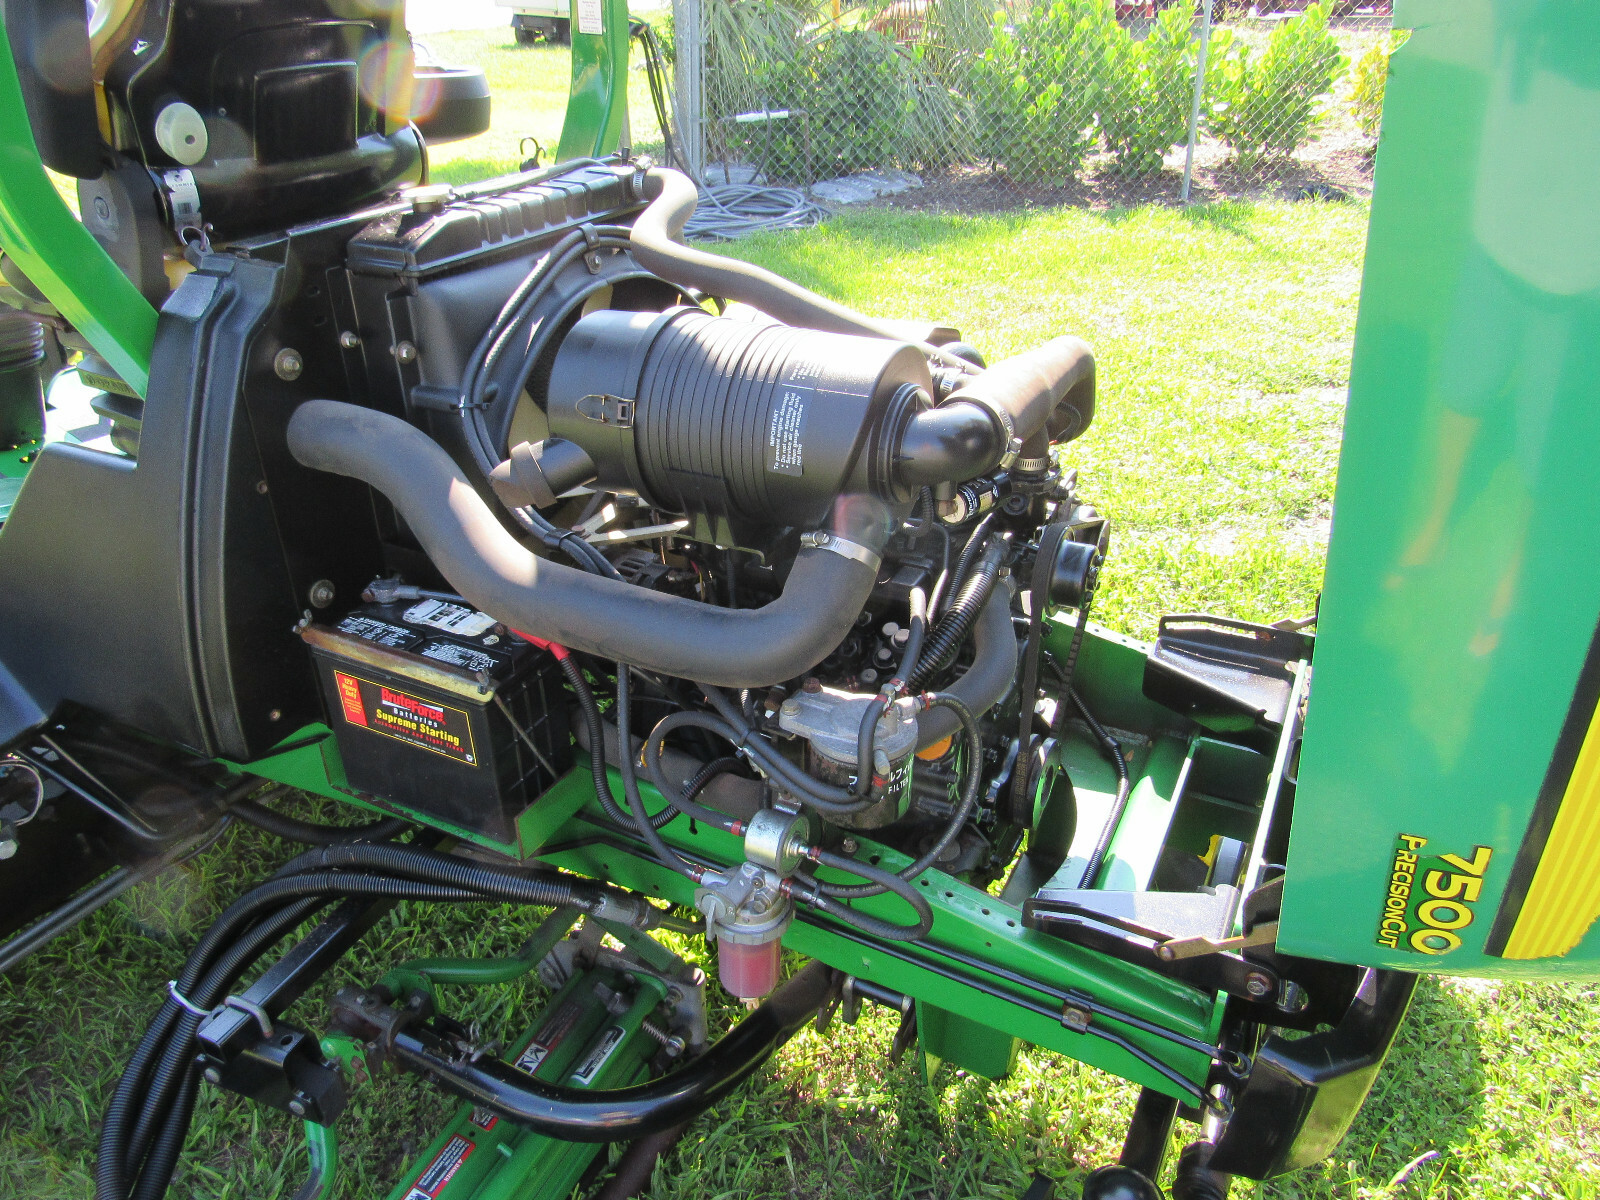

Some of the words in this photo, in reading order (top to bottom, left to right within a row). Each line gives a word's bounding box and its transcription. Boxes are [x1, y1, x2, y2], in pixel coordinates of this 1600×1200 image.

[787, 392, 796, 405] fluid
[783, 406, 793, 429] starting
[788, 409, 796, 431] cleaner
[793, 395, 801, 408] only
[795, 404, 803, 427] reaches
[769, 409, 779, 446] IMPORTANT
[773, 461, 779, 469] To
[779, 391, 789, 416] damage:
[780, 454, 786, 462] Do
[342, 683, 358, 694] Heavy
[343, 677, 354, 687] 12V
[345, 690, 357, 700] Duty
[381, 688, 444, 722] BruteForce
[376, 708, 417, 731] Supreme
[419, 724, 460, 747] Starting
[393, 707, 439, 728] Batteries
[426, 735, 444, 746] Light
[445, 740, 465, 753] Truck
[887, 777, 910, 795] FILTER
[1376, 833, 1428, 949] PRECISIONCUT
[1407, 844, 1494, 956] 7500
[443, 1162, 460, 1182] DANGER
